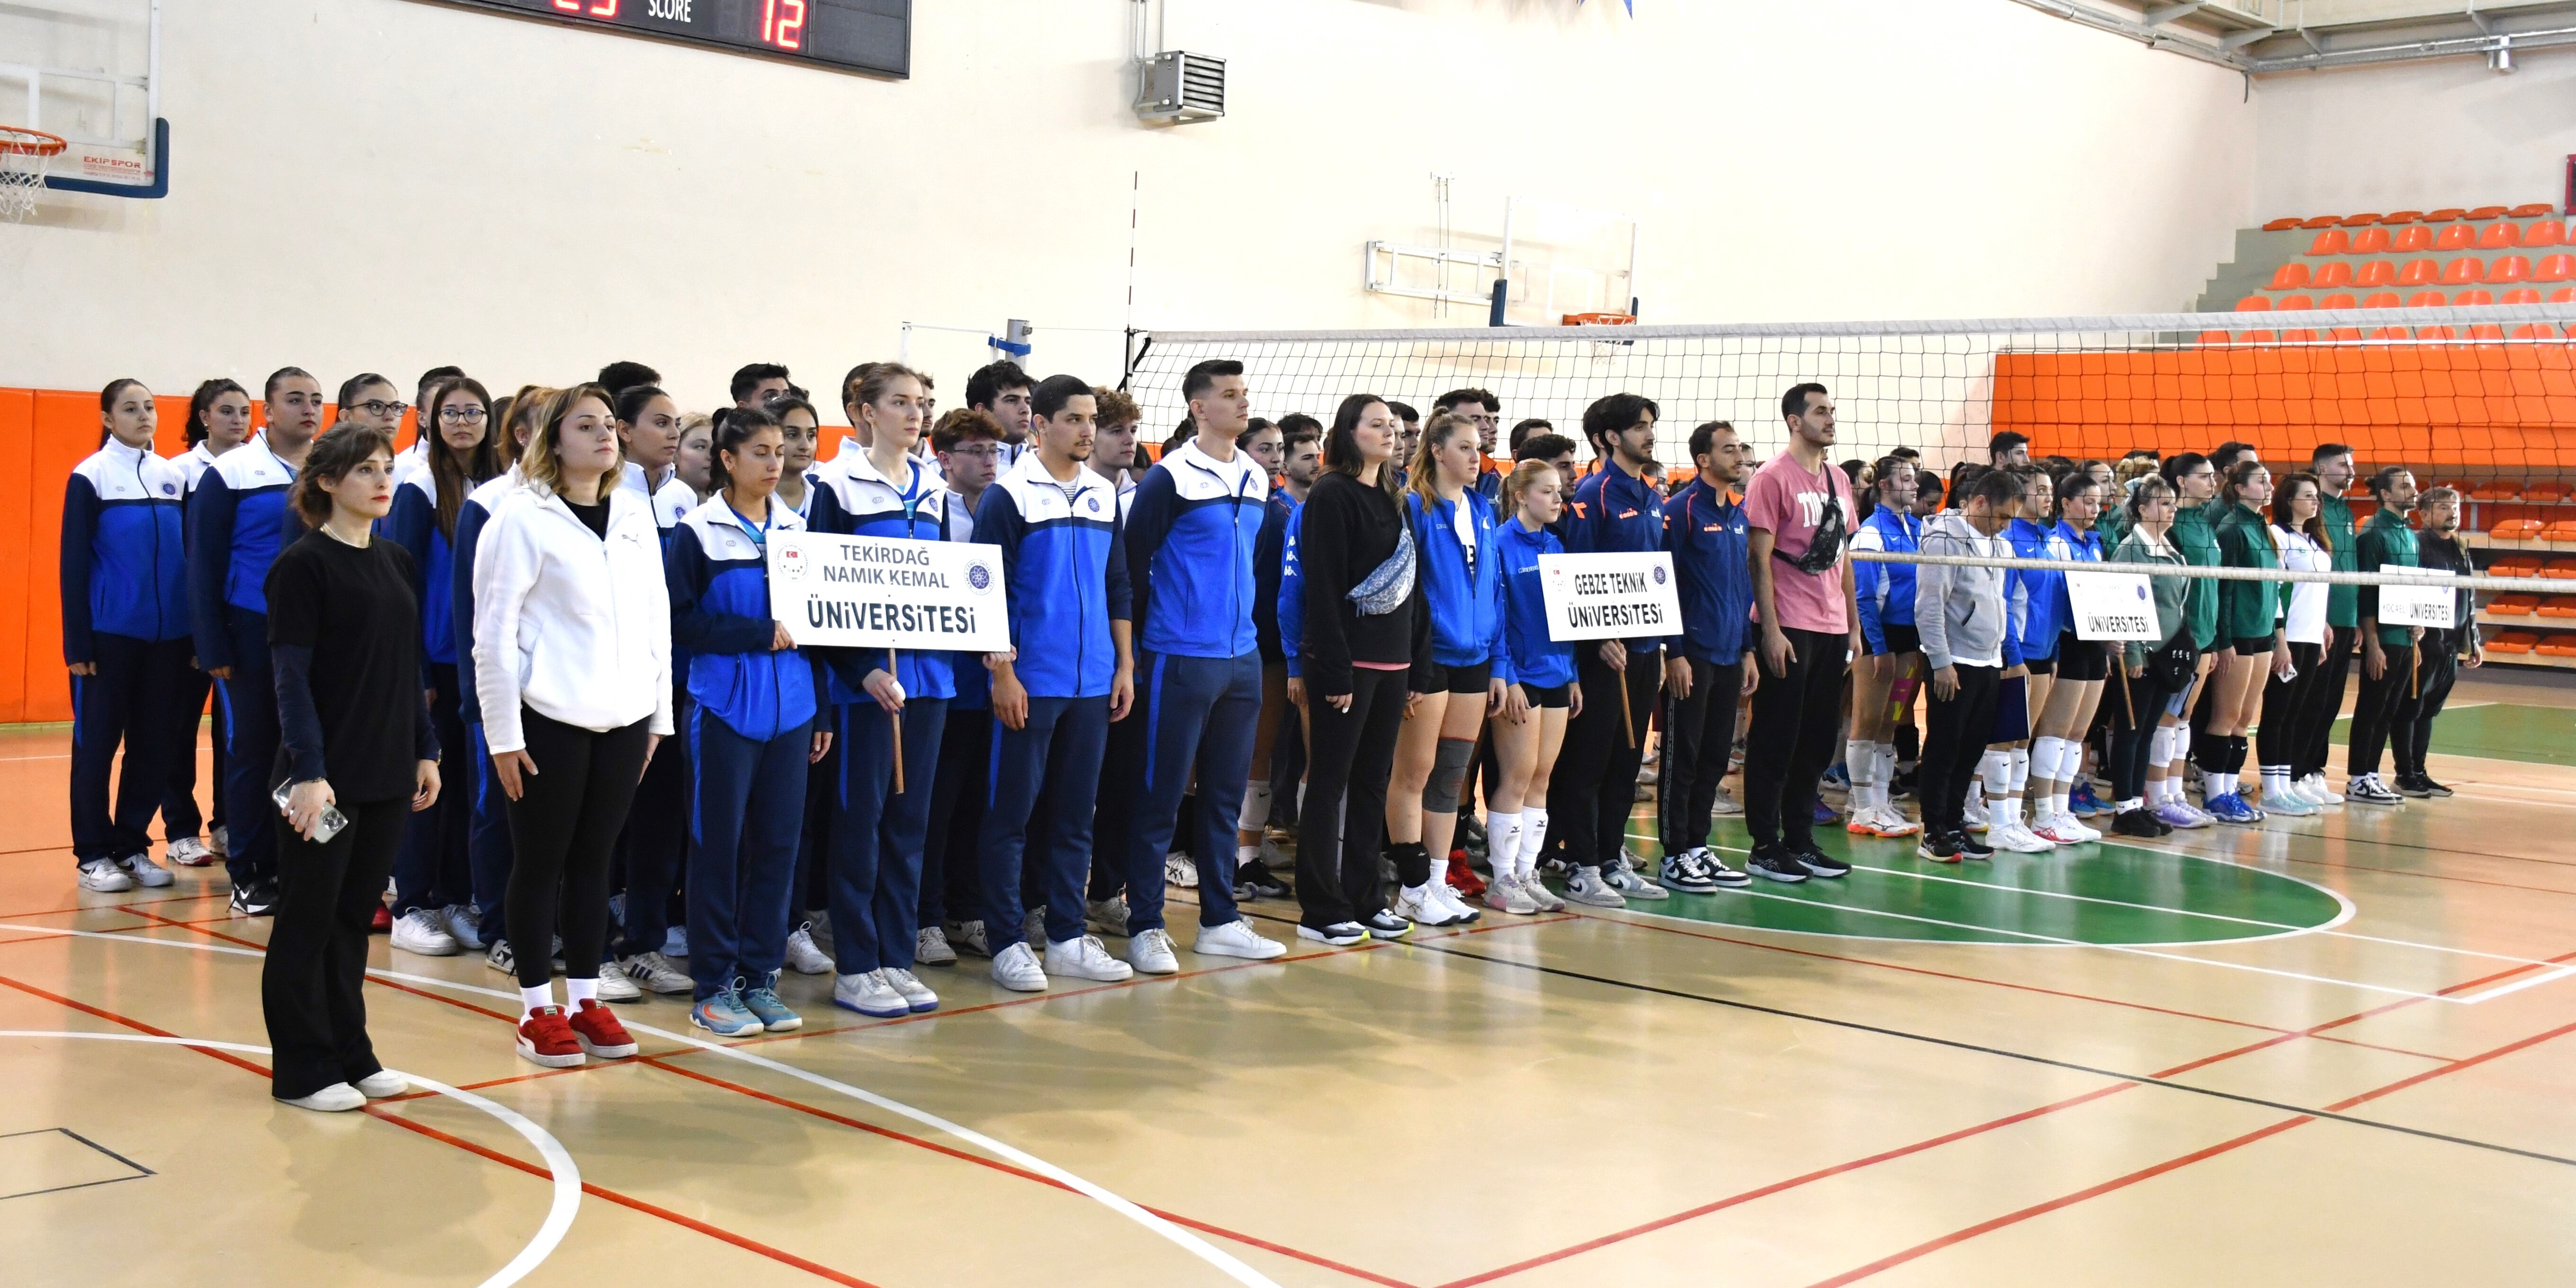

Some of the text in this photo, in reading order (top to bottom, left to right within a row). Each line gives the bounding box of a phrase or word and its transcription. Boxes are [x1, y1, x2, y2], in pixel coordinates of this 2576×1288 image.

[648, 0, 691, 23] SCORE
[764, 0, 804, 48] 12
[111, 160, 141, 169] SPOR
[840, 543, 930, 566] TEKİRDAĞ
[823, 565, 950, 589] NAMIK KEMAL
[1574, 574, 1608, 595] GEBZE
